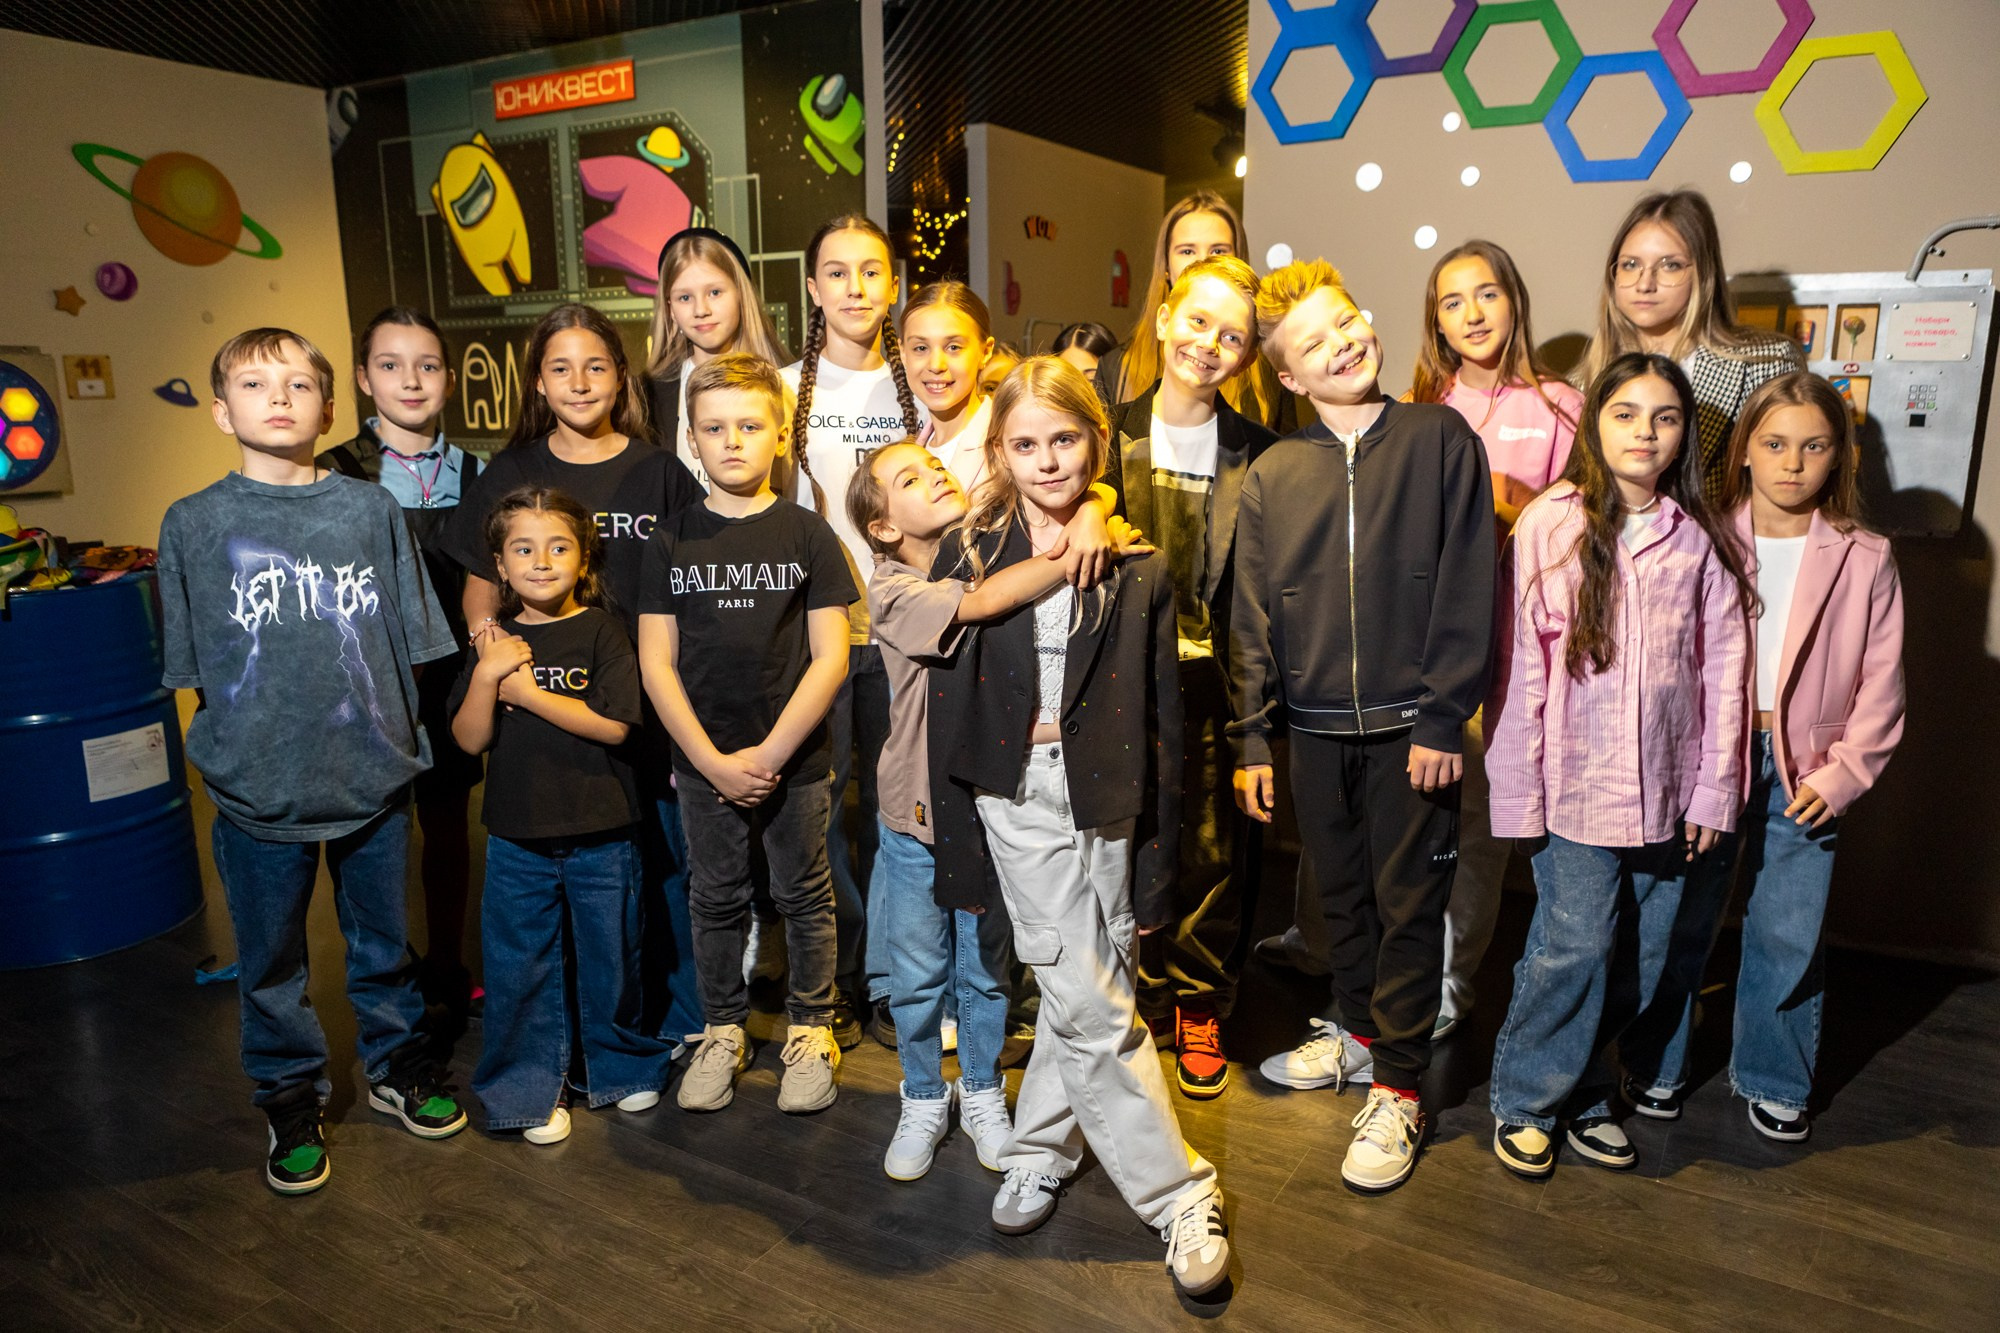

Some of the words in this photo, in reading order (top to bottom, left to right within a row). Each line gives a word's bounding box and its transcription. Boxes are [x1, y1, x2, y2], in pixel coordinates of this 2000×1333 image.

[496, 66, 631, 111] ЮНИКВЕСТ
[808, 415, 846, 428] OLCE
[856, 416, 924, 430] GABBAA
[842, 434, 891, 443] MILANO
[593, 512, 657, 540] ERG
[670, 562, 808, 595] BALMAIN
[227, 556, 287, 631] LET
[295, 553, 324, 621] IT
[331, 560, 379, 621] BE
[718, 599, 755, 608] PARIS
[533, 667, 589, 690] ERG
[1401, 708, 1419, 718] EMPO
